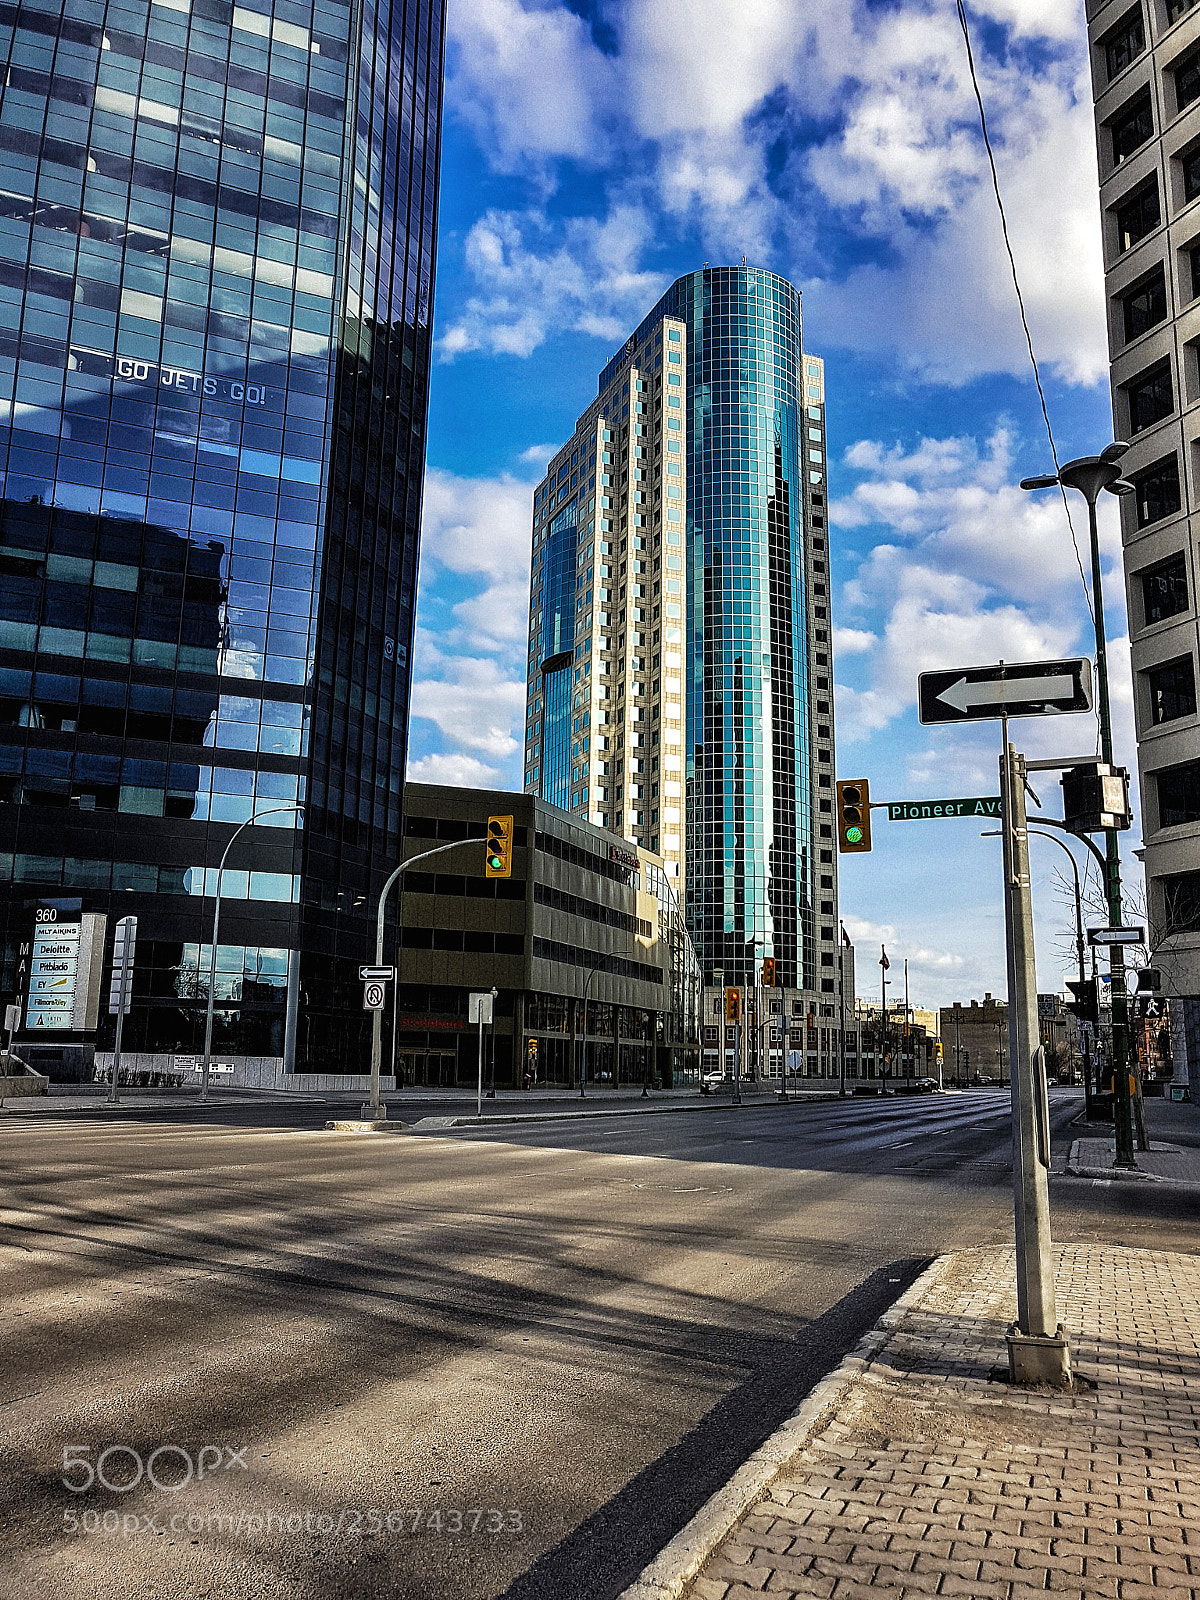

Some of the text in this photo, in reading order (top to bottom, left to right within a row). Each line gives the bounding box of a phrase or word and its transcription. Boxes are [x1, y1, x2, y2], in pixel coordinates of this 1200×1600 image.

[117, 358, 266, 405] GO JETS GO!
[892, 804, 964, 819] Pioneer
[35, 908, 57, 922] 360
[37, 981, 47, 989] EY
